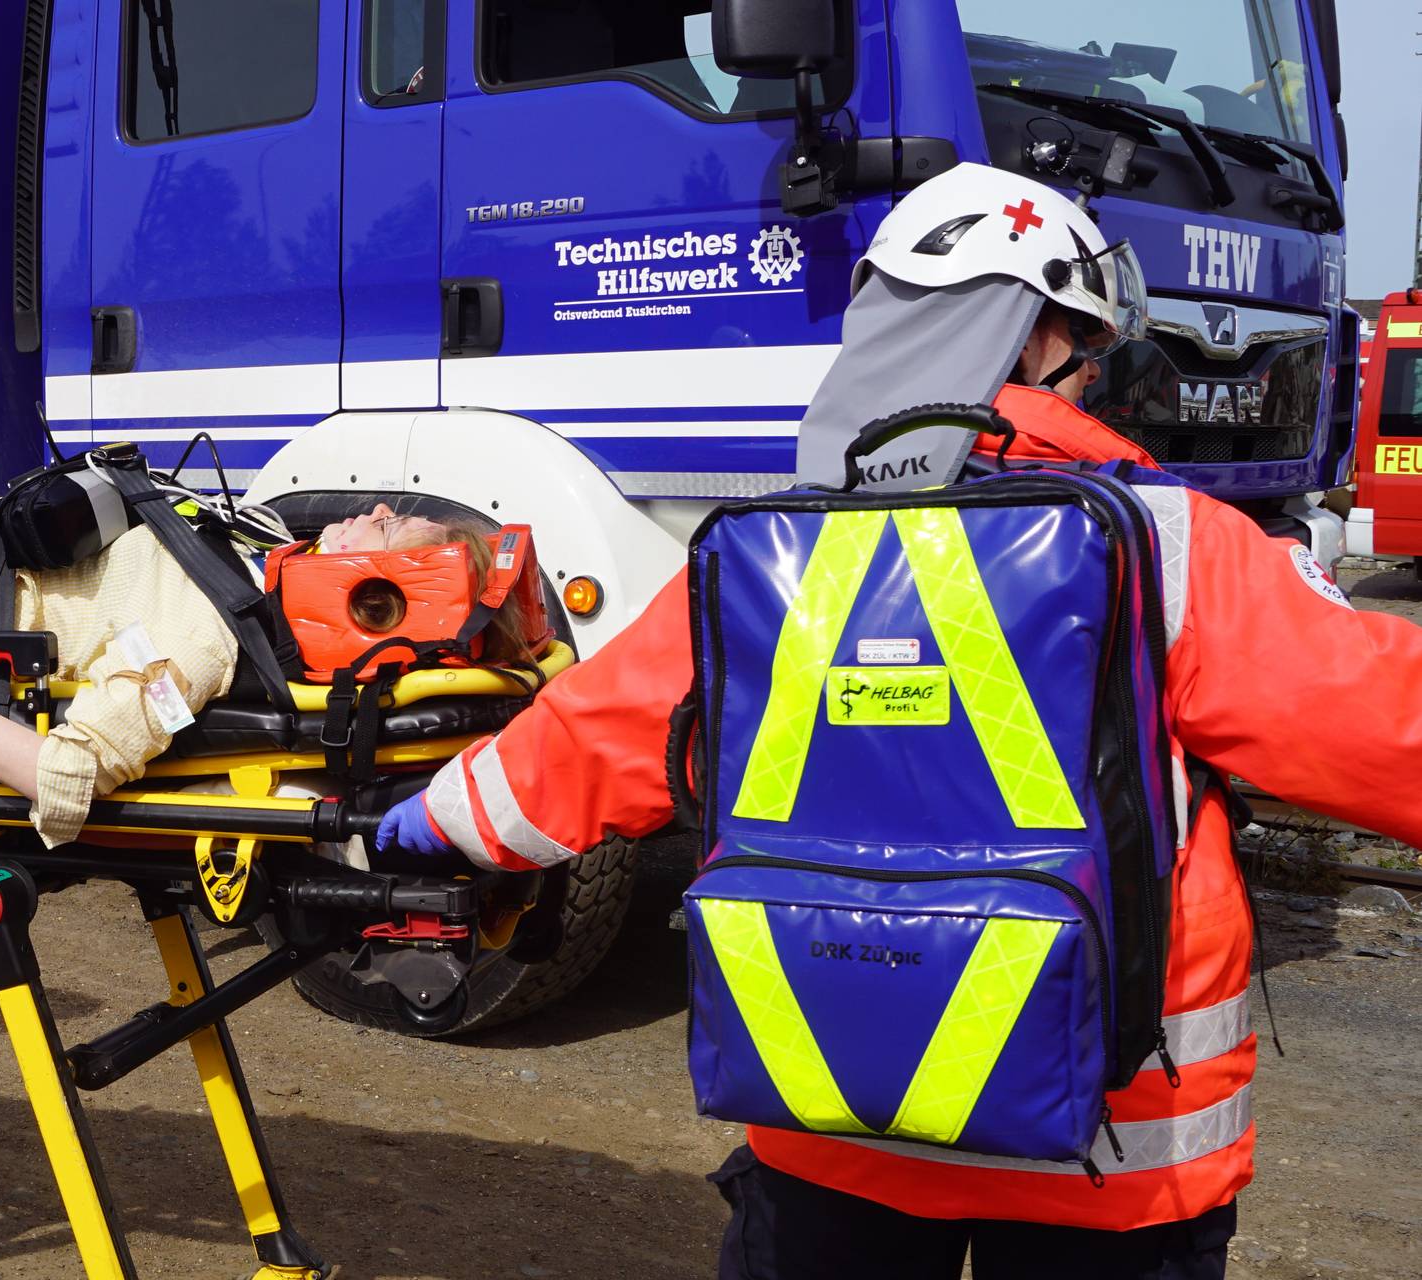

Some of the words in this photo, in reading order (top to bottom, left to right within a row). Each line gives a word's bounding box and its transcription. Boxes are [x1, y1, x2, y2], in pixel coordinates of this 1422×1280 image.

[466, 204, 507, 223] TGM
[510, 197, 585, 220] 18.290
[554, 231, 737, 267] Technisches
[1183, 223, 1261, 293] THW
[597, 263, 738, 296] Hilfswerk
[553, 307, 623, 321] Ortsverband
[625, 304, 691, 318] Euskirchen
[1179, 382, 1262, 423] MAN
[858, 455, 931, 485] KASK
[871, 685, 934, 700] HELBAG
[885, 703, 910, 712] Profi
[913, 703, 920, 712] L
[810, 940, 853, 961] DRK
